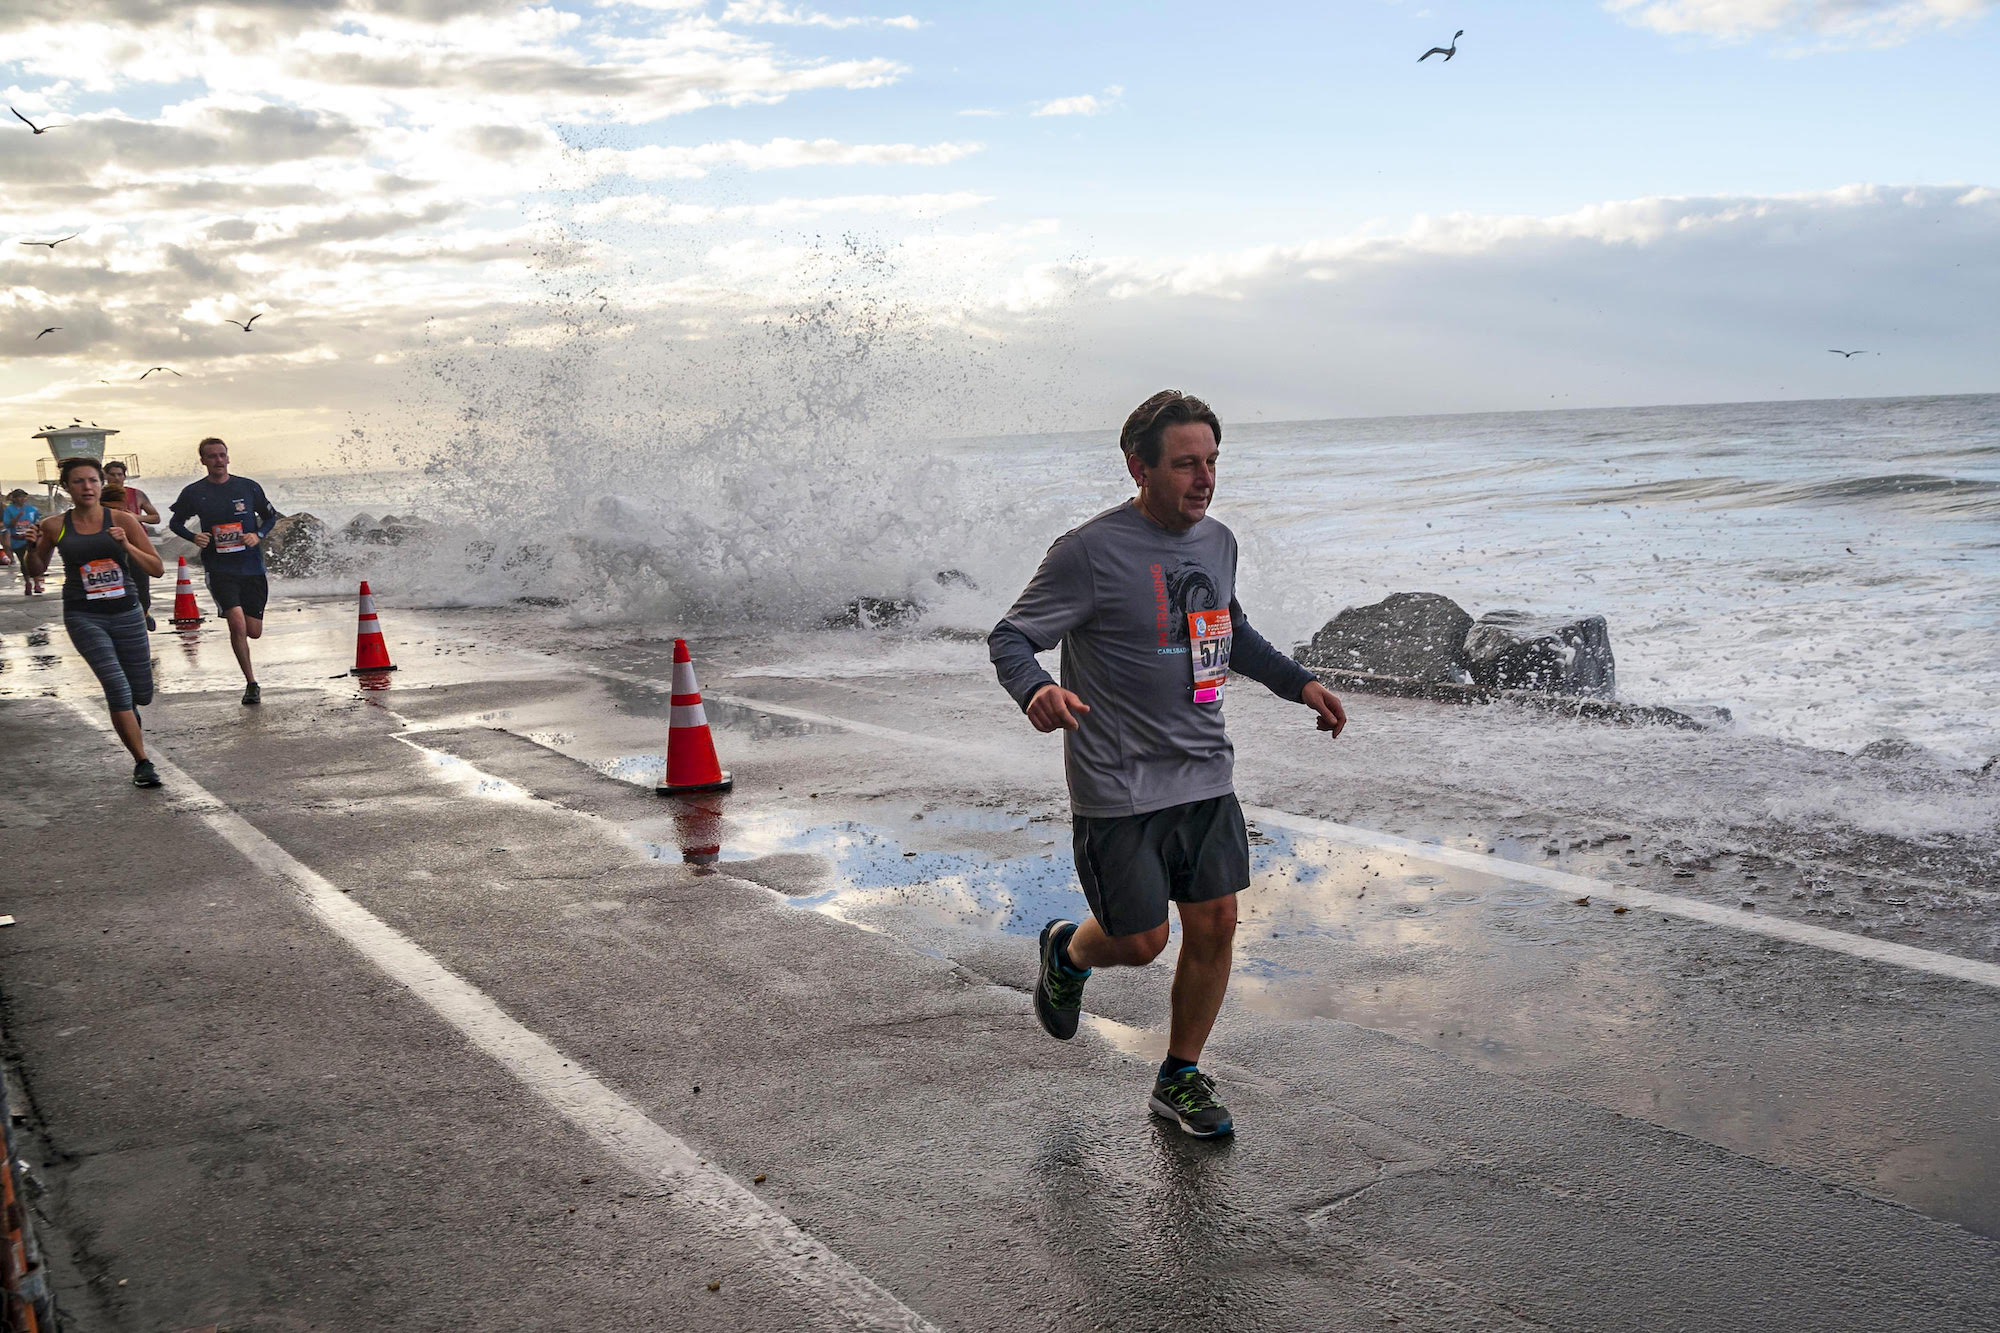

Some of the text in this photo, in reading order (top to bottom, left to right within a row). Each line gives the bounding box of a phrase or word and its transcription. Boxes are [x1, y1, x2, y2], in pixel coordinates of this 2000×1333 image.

[88, 570, 119, 586] 6450
[1150, 563, 1169, 647] IN TRAINING
[1157, 647, 1186, 655] CARLSBAD
